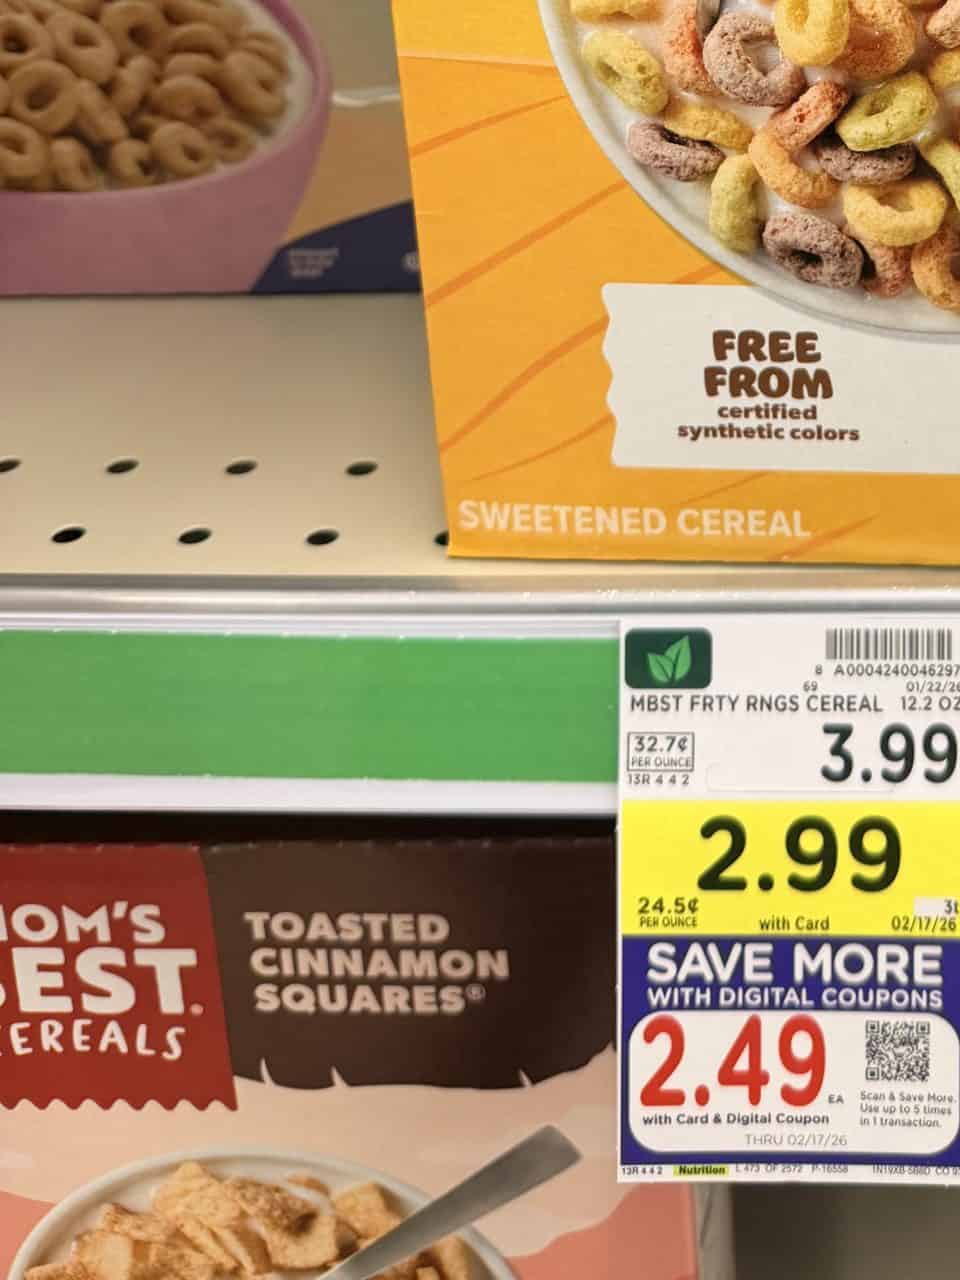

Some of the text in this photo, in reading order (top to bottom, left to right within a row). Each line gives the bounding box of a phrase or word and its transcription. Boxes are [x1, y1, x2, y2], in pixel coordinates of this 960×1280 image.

[712, 329, 821, 363] FREE
[703, 366, 833, 400] FROM
[717, 402, 818, 421] certified
[677, 423, 860, 442] synthetic colors
[457, 499, 812, 539] SWEETENED CEREAL
[630, 694, 683, 713] MBST
[689, 694, 739, 713] FRTY
[746, 694, 800, 713] RNGS
[805, 694, 884, 713] CEREAL
[900, 696, 933, 712] 12.2
[634, 735, 689, 753] 32.7¢
[820, 722, 959, 784] 3.99
[631, 756, 693, 769] PER OUNCE
[628, 773, 690, 786] 13R 4 4 2
[696, 815, 902, 893] 2.99
[637, 896, 699, 916] 24.5¢
[0, 901, 166, 944] OM'S
[243, 911, 450, 945] TOASTED
[639, 916, 698, 928] PER OUNCE
[758, 917, 830, 932] with Card
[891, 916, 958, 933] 02/17/26
[249, 948, 510, 980] CINNAMON
[646, 942, 943, 987] SAVE MORE
[0, 947, 197, 1016] EST
[647, 987, 943, 1010] WITH DIGITAL COUPONS
[0, 1019, 186, 1061] EREALS
[640, 1013, 845, 1108] 2.49 EA
[860, 1090, 885, 1101] Scan
[899, 1091, 925, 1102] Save
[860, 1103, 880, 1113] Use
[883, 1104, 897, 1115] up
[923, 1105, 952, 1116] times
[642, 1112, 831, 1129] with Card & Digital Coupon
[745, 1133, 848, 1147] THRU 02/17/26
[678, 1165, 727, 1176] Nutrition
